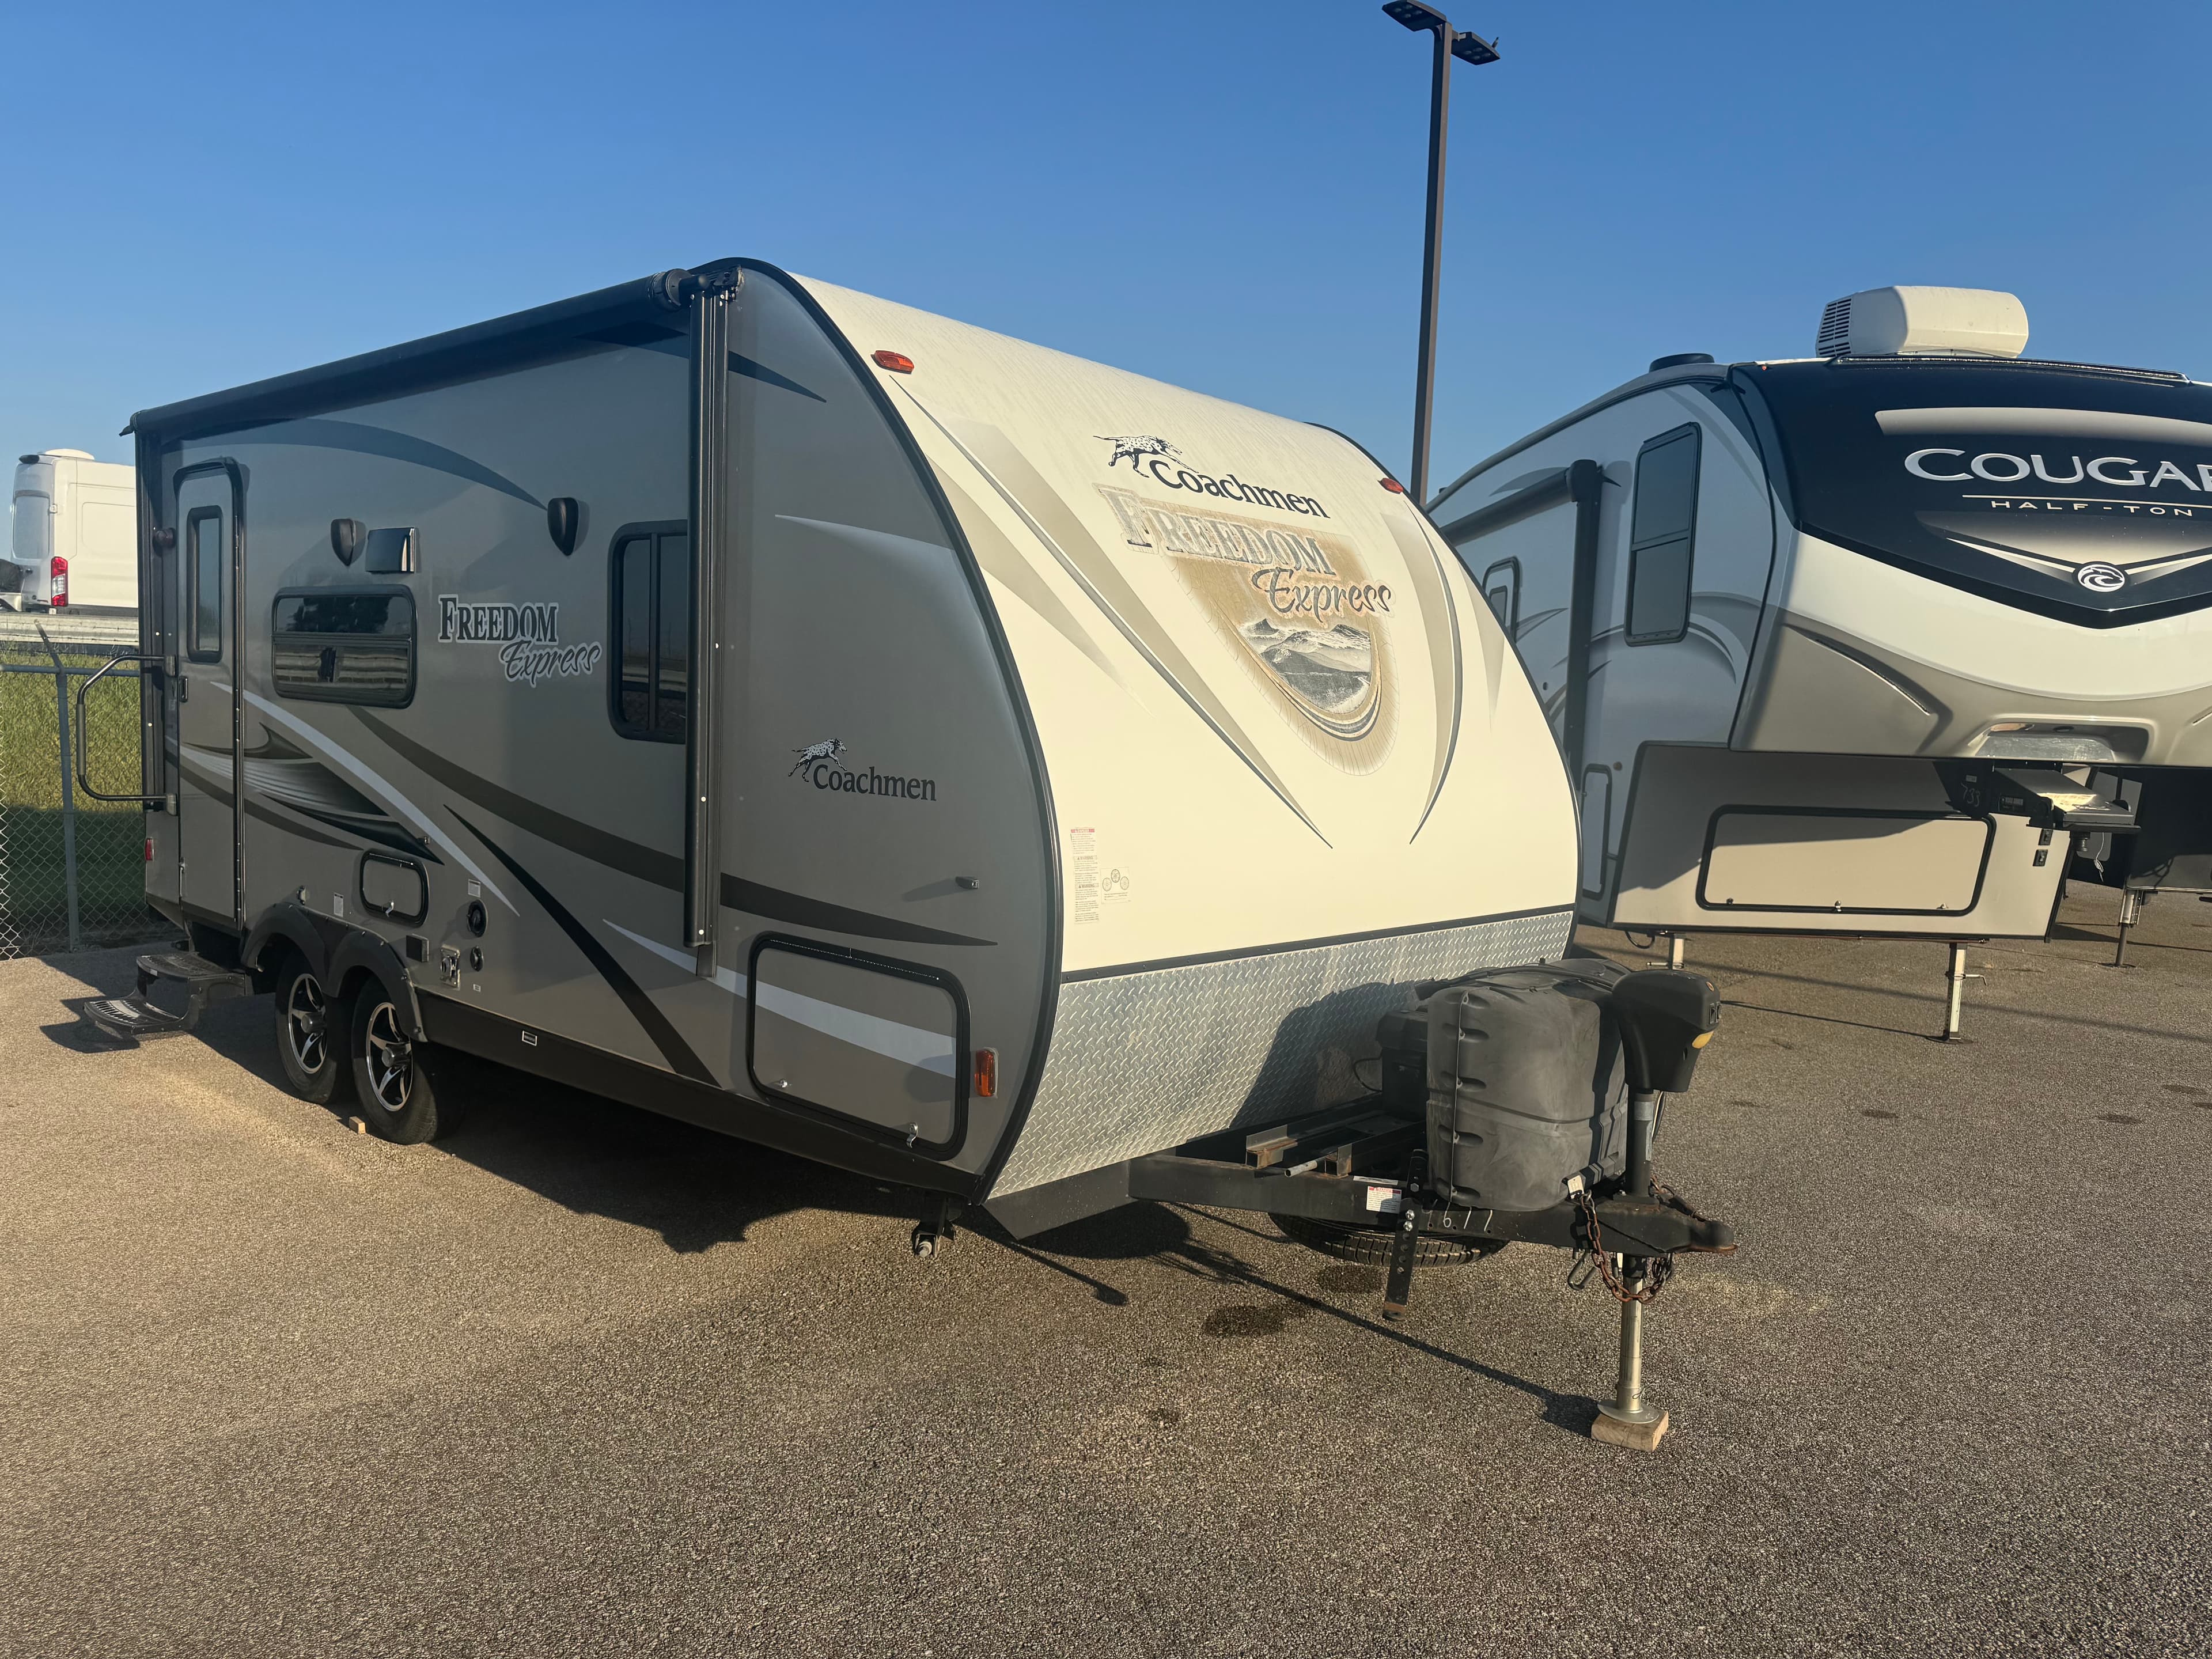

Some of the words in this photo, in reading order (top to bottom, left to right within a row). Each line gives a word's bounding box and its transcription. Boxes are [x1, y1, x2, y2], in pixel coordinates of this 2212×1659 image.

[1149, 459, 1331, 519] Coachmen
[1991, 500, 2193, 517] HALF-TON
[1098, 487, 1335, 576] FREEDOM
[1252, 566, 1392, 623] Express
[438, 597, 558, 642] FREEDOM
[500, 640, 600, 685] Express
[813, 764, 937, 801] Coachmen
